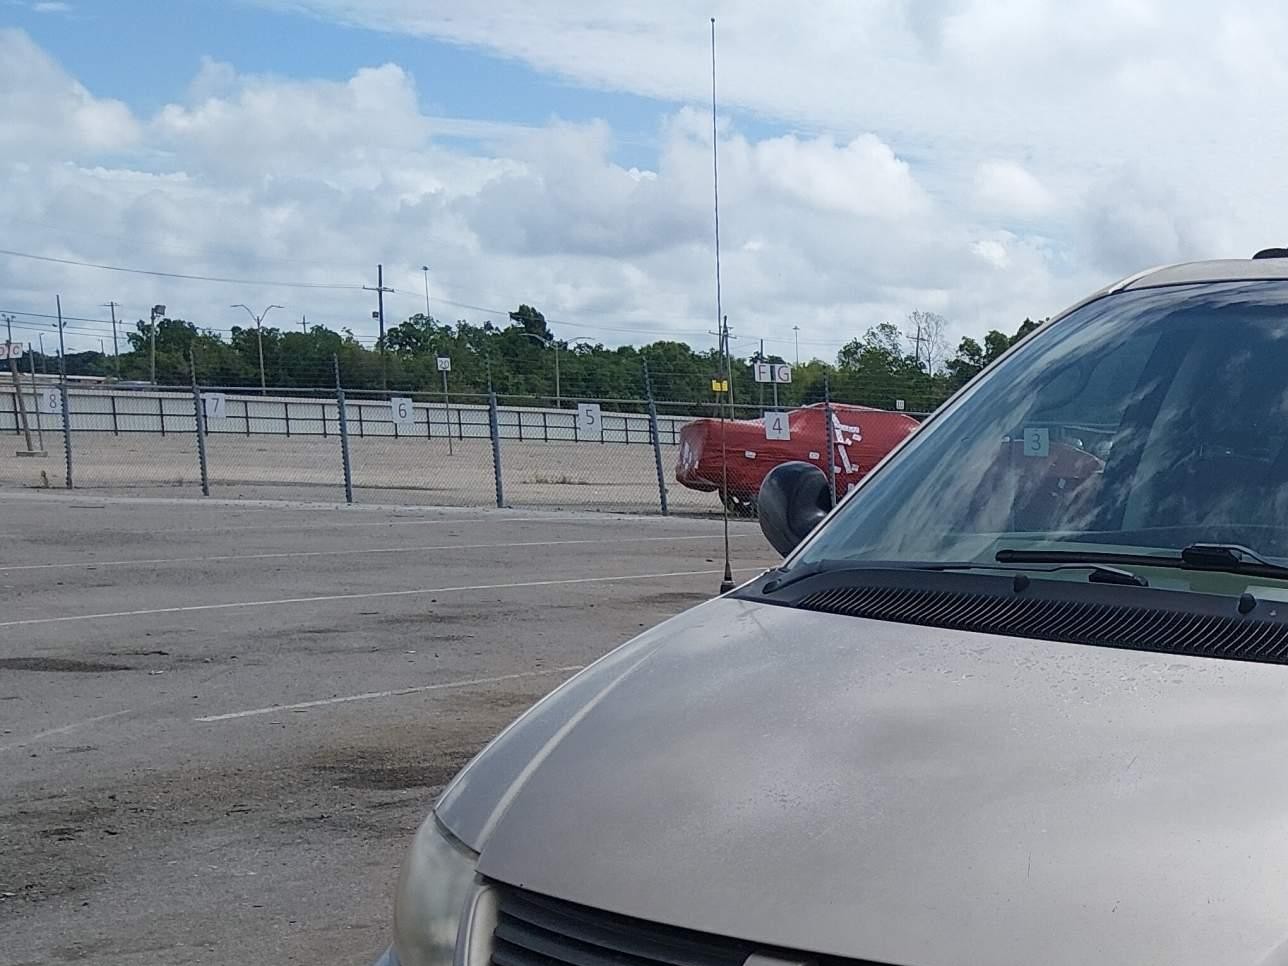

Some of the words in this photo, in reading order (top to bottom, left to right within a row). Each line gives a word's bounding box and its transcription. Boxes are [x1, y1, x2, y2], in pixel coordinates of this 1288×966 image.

[439, 360, 449, 369] 20
[758, 365, 766, 380] F
[777, 366, 790, 381] G
[49, 394, 57, 409] 8
[211, 398, 219, 413] 7
[398, 402, 407, 418] 6
[585, 409, 595, 425] 5
[772, 417, 783, 434] 4
[1031, 433, 1041, 451] 3
